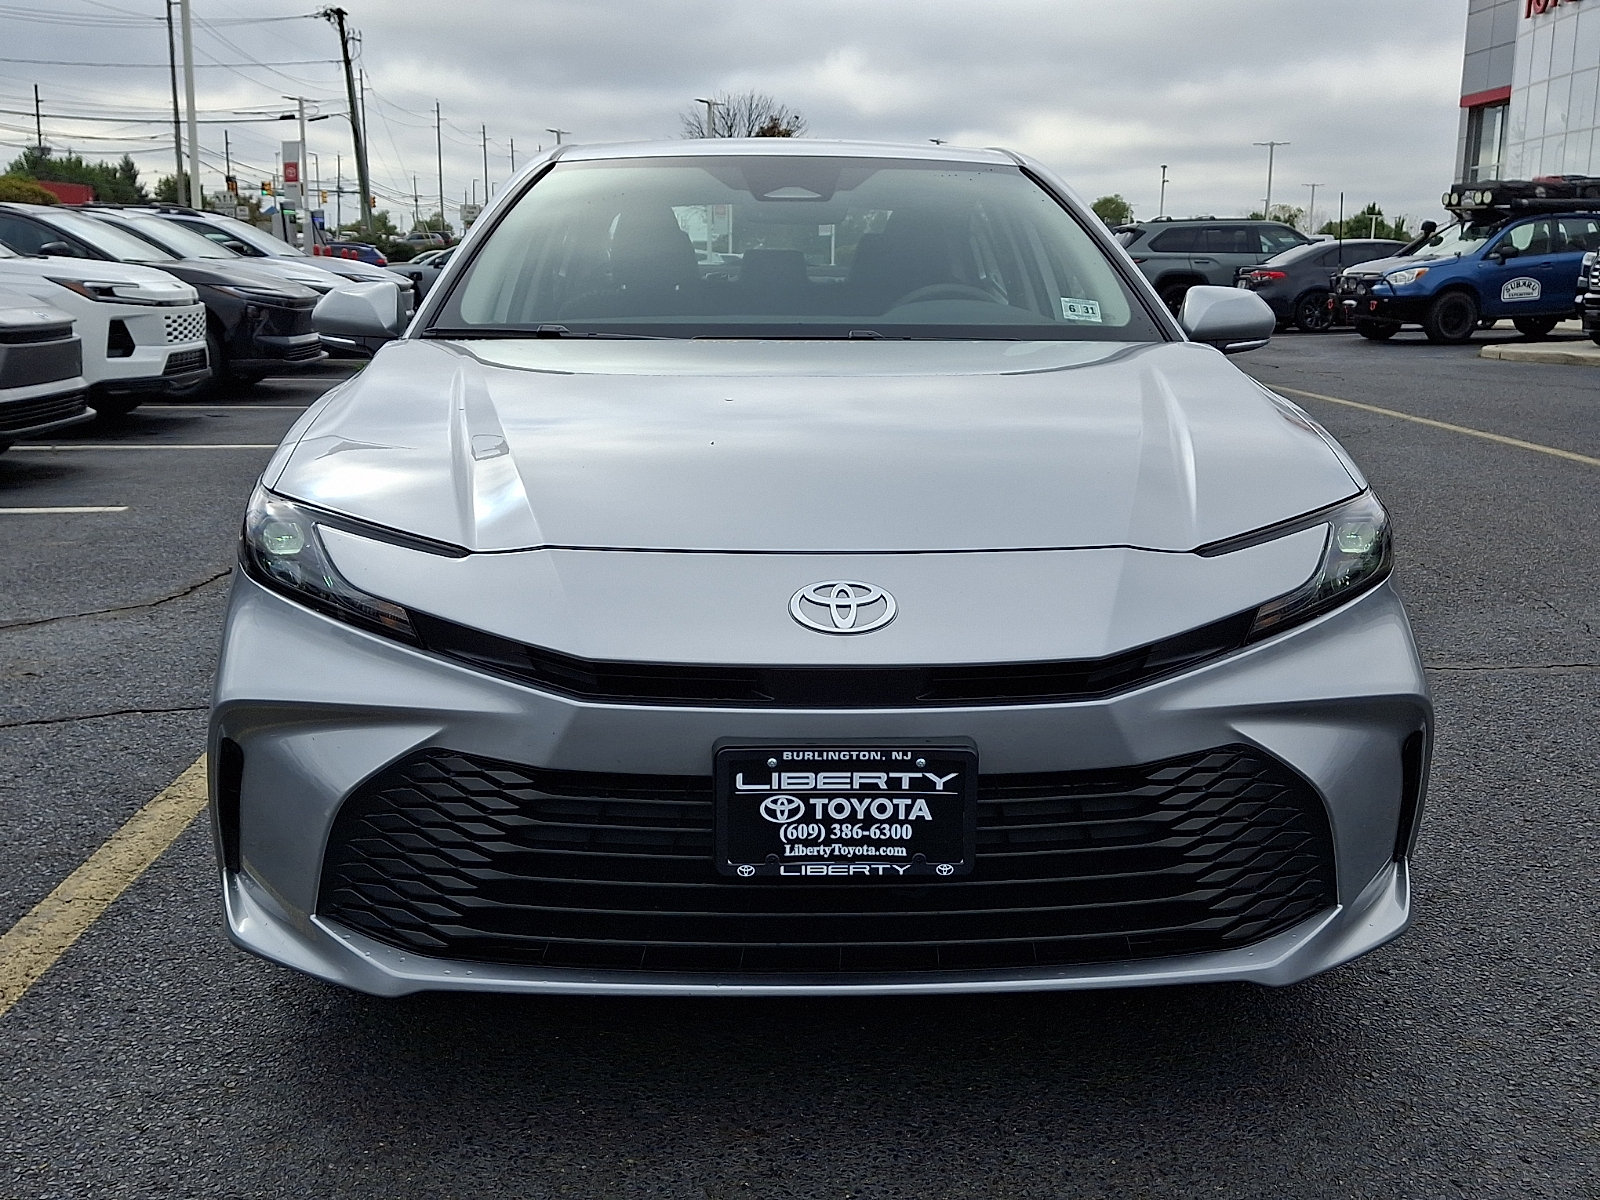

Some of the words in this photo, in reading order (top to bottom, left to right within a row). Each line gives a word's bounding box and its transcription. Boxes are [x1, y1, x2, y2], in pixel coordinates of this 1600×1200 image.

[1505, 281, 1537, 293] SUBARU
[1069, 304, 1076, 313] 6
[1083, 305, 1095, 314] 31
[783, 752, 886, 760] BURLINGTON,
[892, 752, 912, 760] NJ
[736, 772, 959, 790] LIBERTY
[810, 798, 933, 820] TOYOTA
[779, 823, 826, 843] (609)
[830, 823, 913, 840] 386-6300
[784, 844, 907, 857] LibertyToyota.com
[780, 864, 912, 875] LIBERTY
